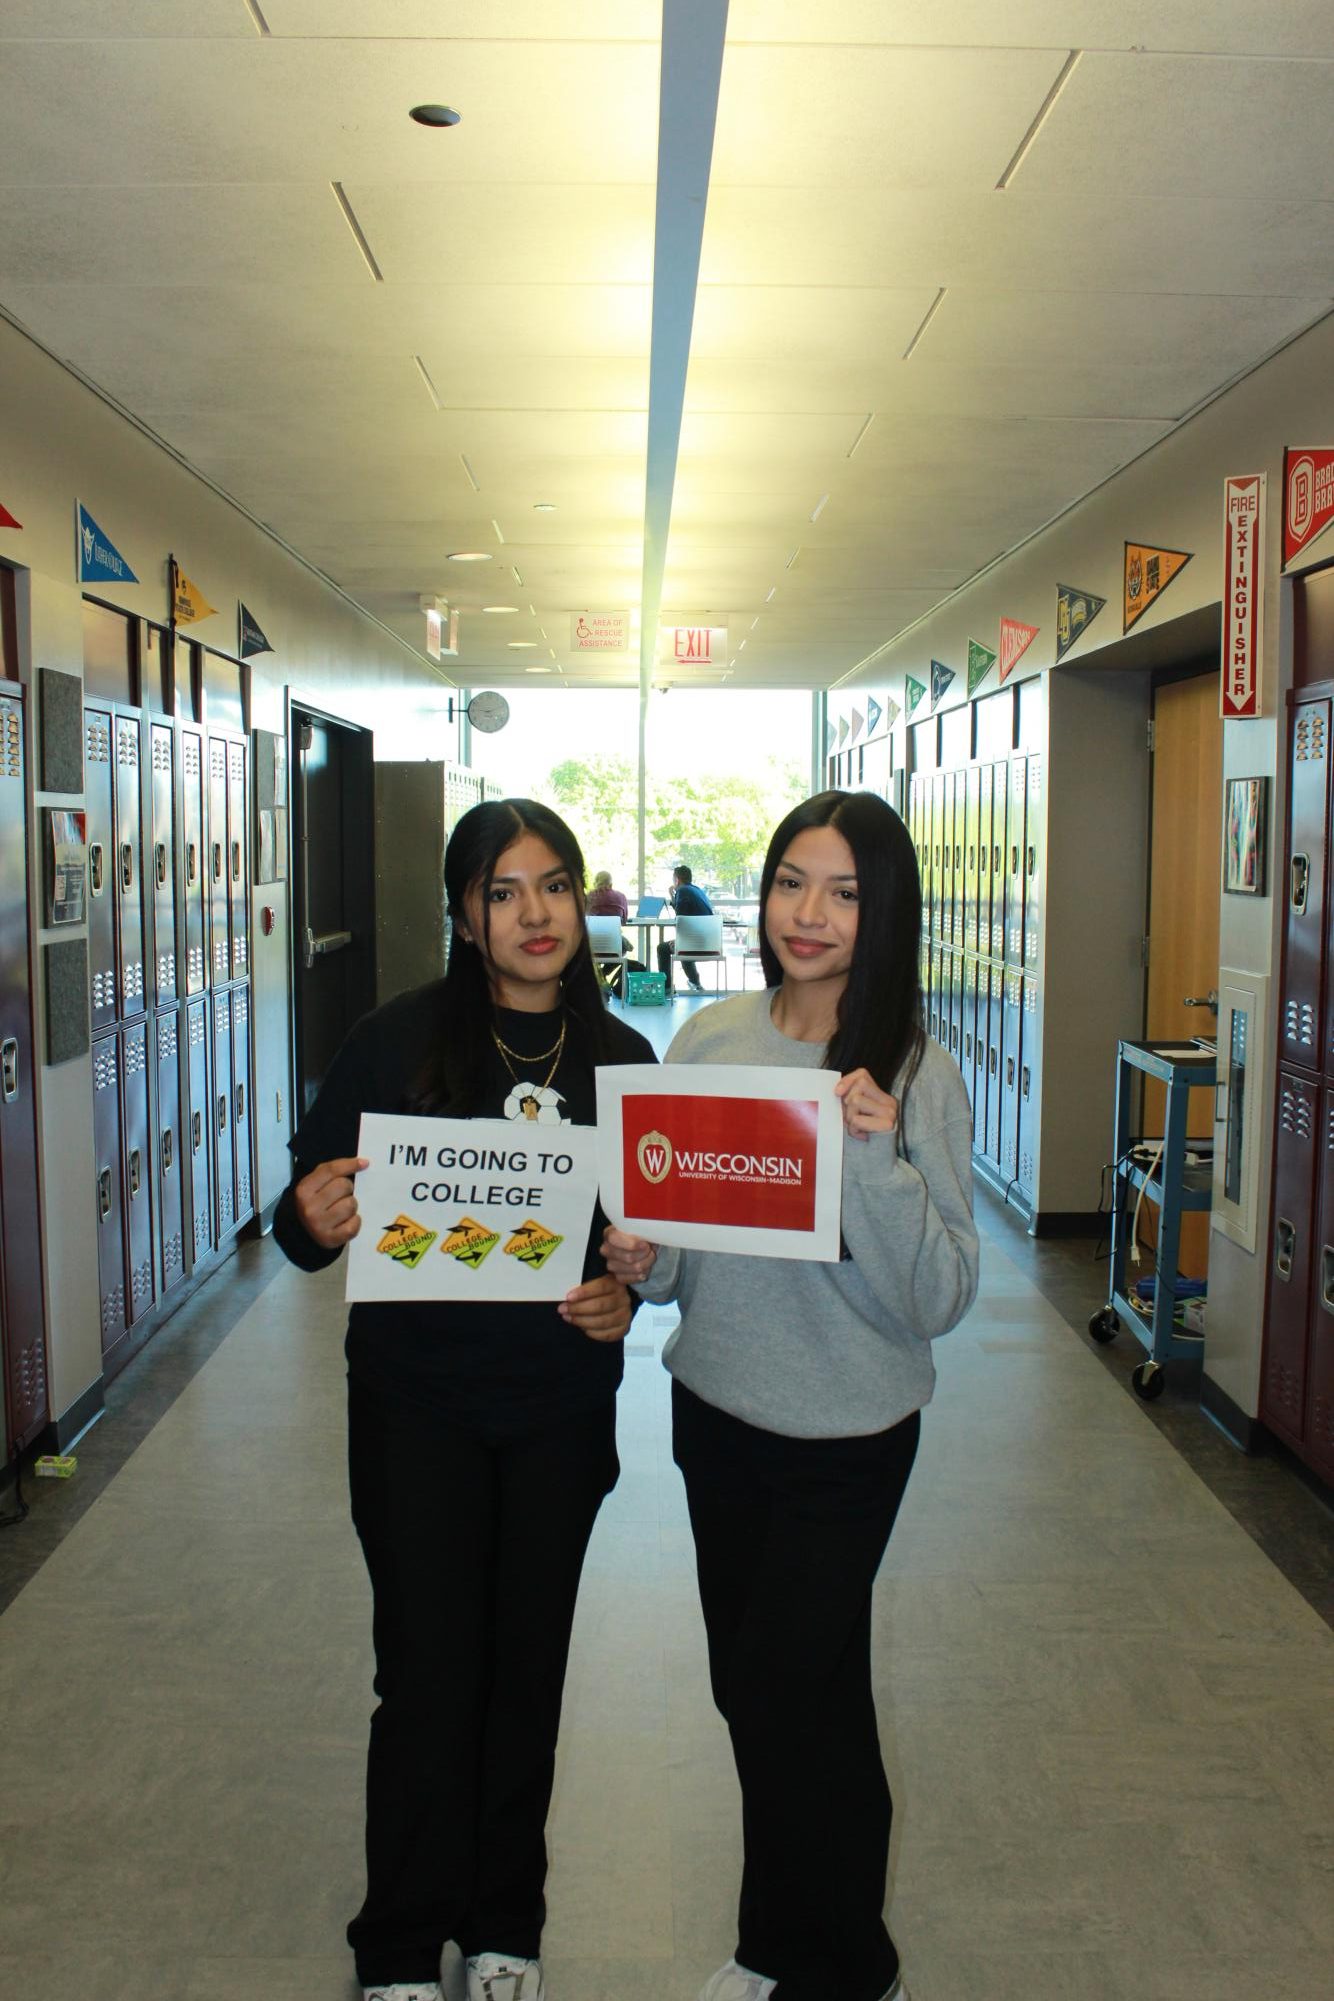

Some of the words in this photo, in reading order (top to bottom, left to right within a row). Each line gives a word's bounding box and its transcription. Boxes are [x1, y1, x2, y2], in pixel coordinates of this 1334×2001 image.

[1231, 496, 1255, 512] FIRE
[1315, 482, 1334, 514] BRA
[1234, 515, 1248, 695] EXTINGUISHER
[579, 639, 622, 647] ASSISTANCE
[674, 629, 712, 657] EXIT
[437, 1147, 528, 1172] GOING
[537, 1153, 573, 1175] TO
[646, 1149, 664, 1174] W
[675, 1151, 803, 1178] WISCONSIN
[679, 1172, 717, 1181] UNIVERSITY
[718, 1174, 728, 1182] OF
[411, 1182, 543, 1207] COLLEGE
[382, 1231, 419, 1253] COLLEGE
[404, 1233, 433, 1250] BOUND
[446, 1233, 483, 1253] COLLEGE
[468, 1234, 497, 1250] BOUND
[509, 1235, 545, 1254] COLLEGE
[531, 1236, 559, 1251] BOUND
